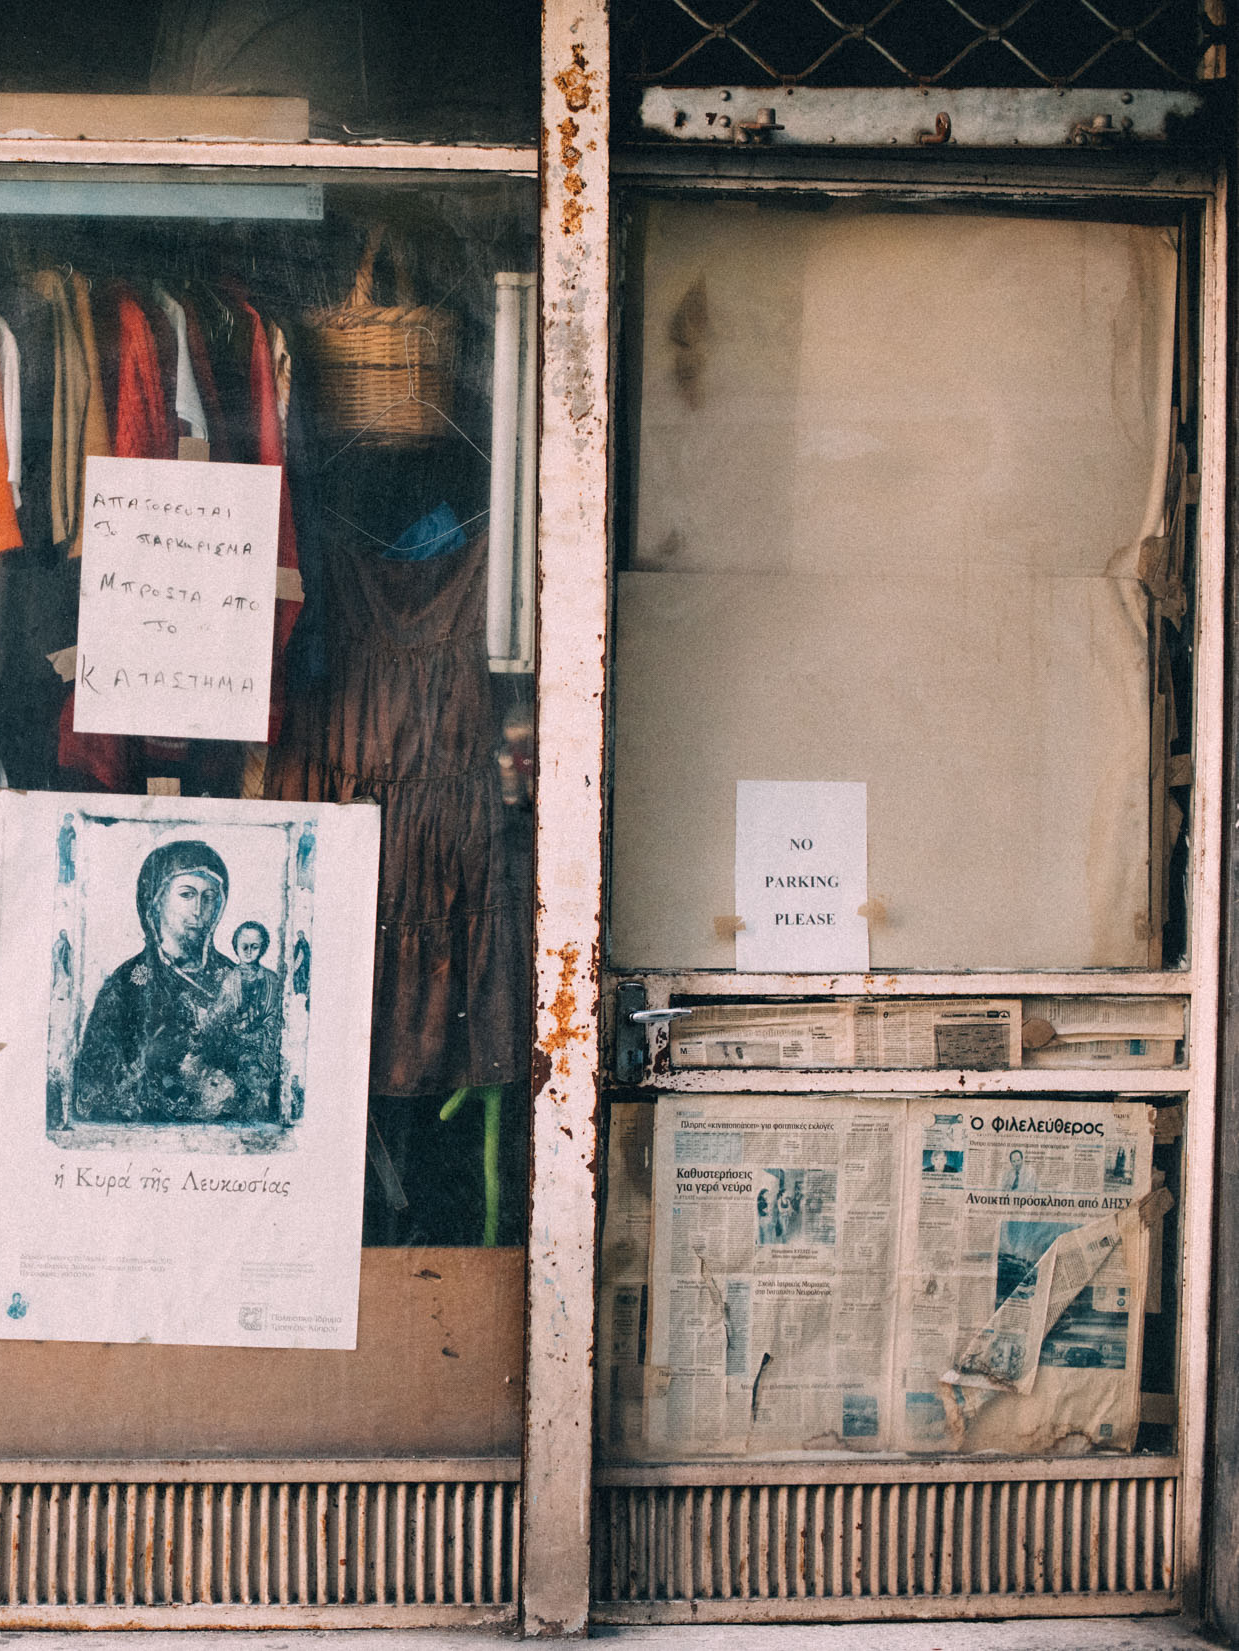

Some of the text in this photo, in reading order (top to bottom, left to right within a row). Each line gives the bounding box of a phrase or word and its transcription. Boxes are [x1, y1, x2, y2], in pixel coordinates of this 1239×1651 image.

[100, 572, 260, 611] ΜΠΡΟΣΤΑ ΑΠΟ
[143, 620, 177, 634] ΤΟ
[81, 653, 255, 695] ΚΑΤΑΣΤΗΜΑ
[790, 838, 813, 850] NO
[765, 875, 839, 888] PARKING
[775, 913, 836, 925] PLEASE
[991, 1116, 1105, 1137] Φιλελεύθερος
[76, 1162, 133, 1197] Κυρά
[181, 1167, 291, 1197] Λευκωσίας
[676, 1168, 753, 1181] Καθυστερήσεις
[676, 1182, 753, 1194] για γερά νεύρα
[965, 1193, 1010, 1206] Ανοικτή
[1013, 1194, 1075, 1208] πρόσκληση
[1077, 1197, 1099, 1208] από
